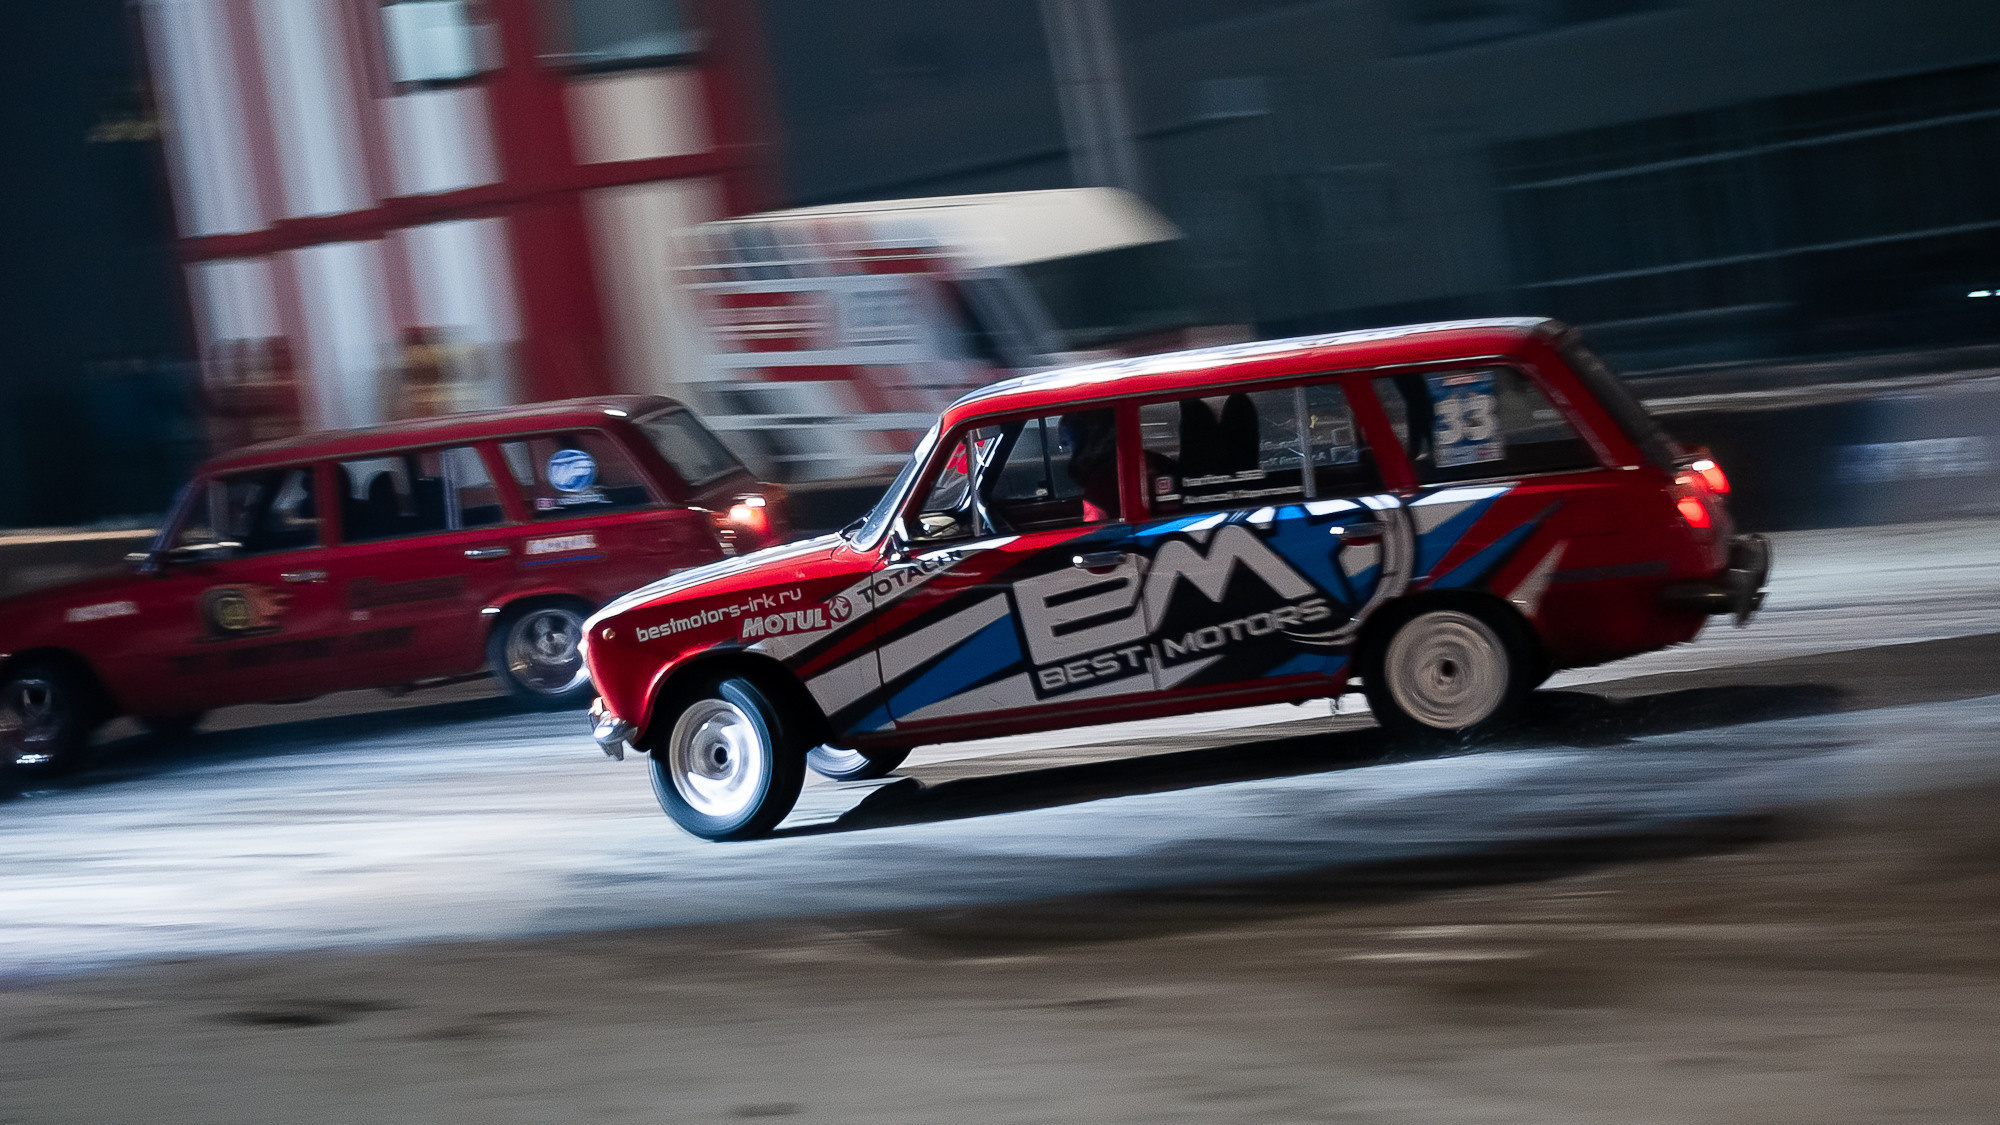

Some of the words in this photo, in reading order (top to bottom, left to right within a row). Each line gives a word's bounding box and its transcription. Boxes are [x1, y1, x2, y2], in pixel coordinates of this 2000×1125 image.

[1434, 394, 1496, 445] 33
[742, 608, 827, 638] MOTUL
[1037, 645, 1146, 691] BEST
[1162, 598, 1333, 659] MOTORS
